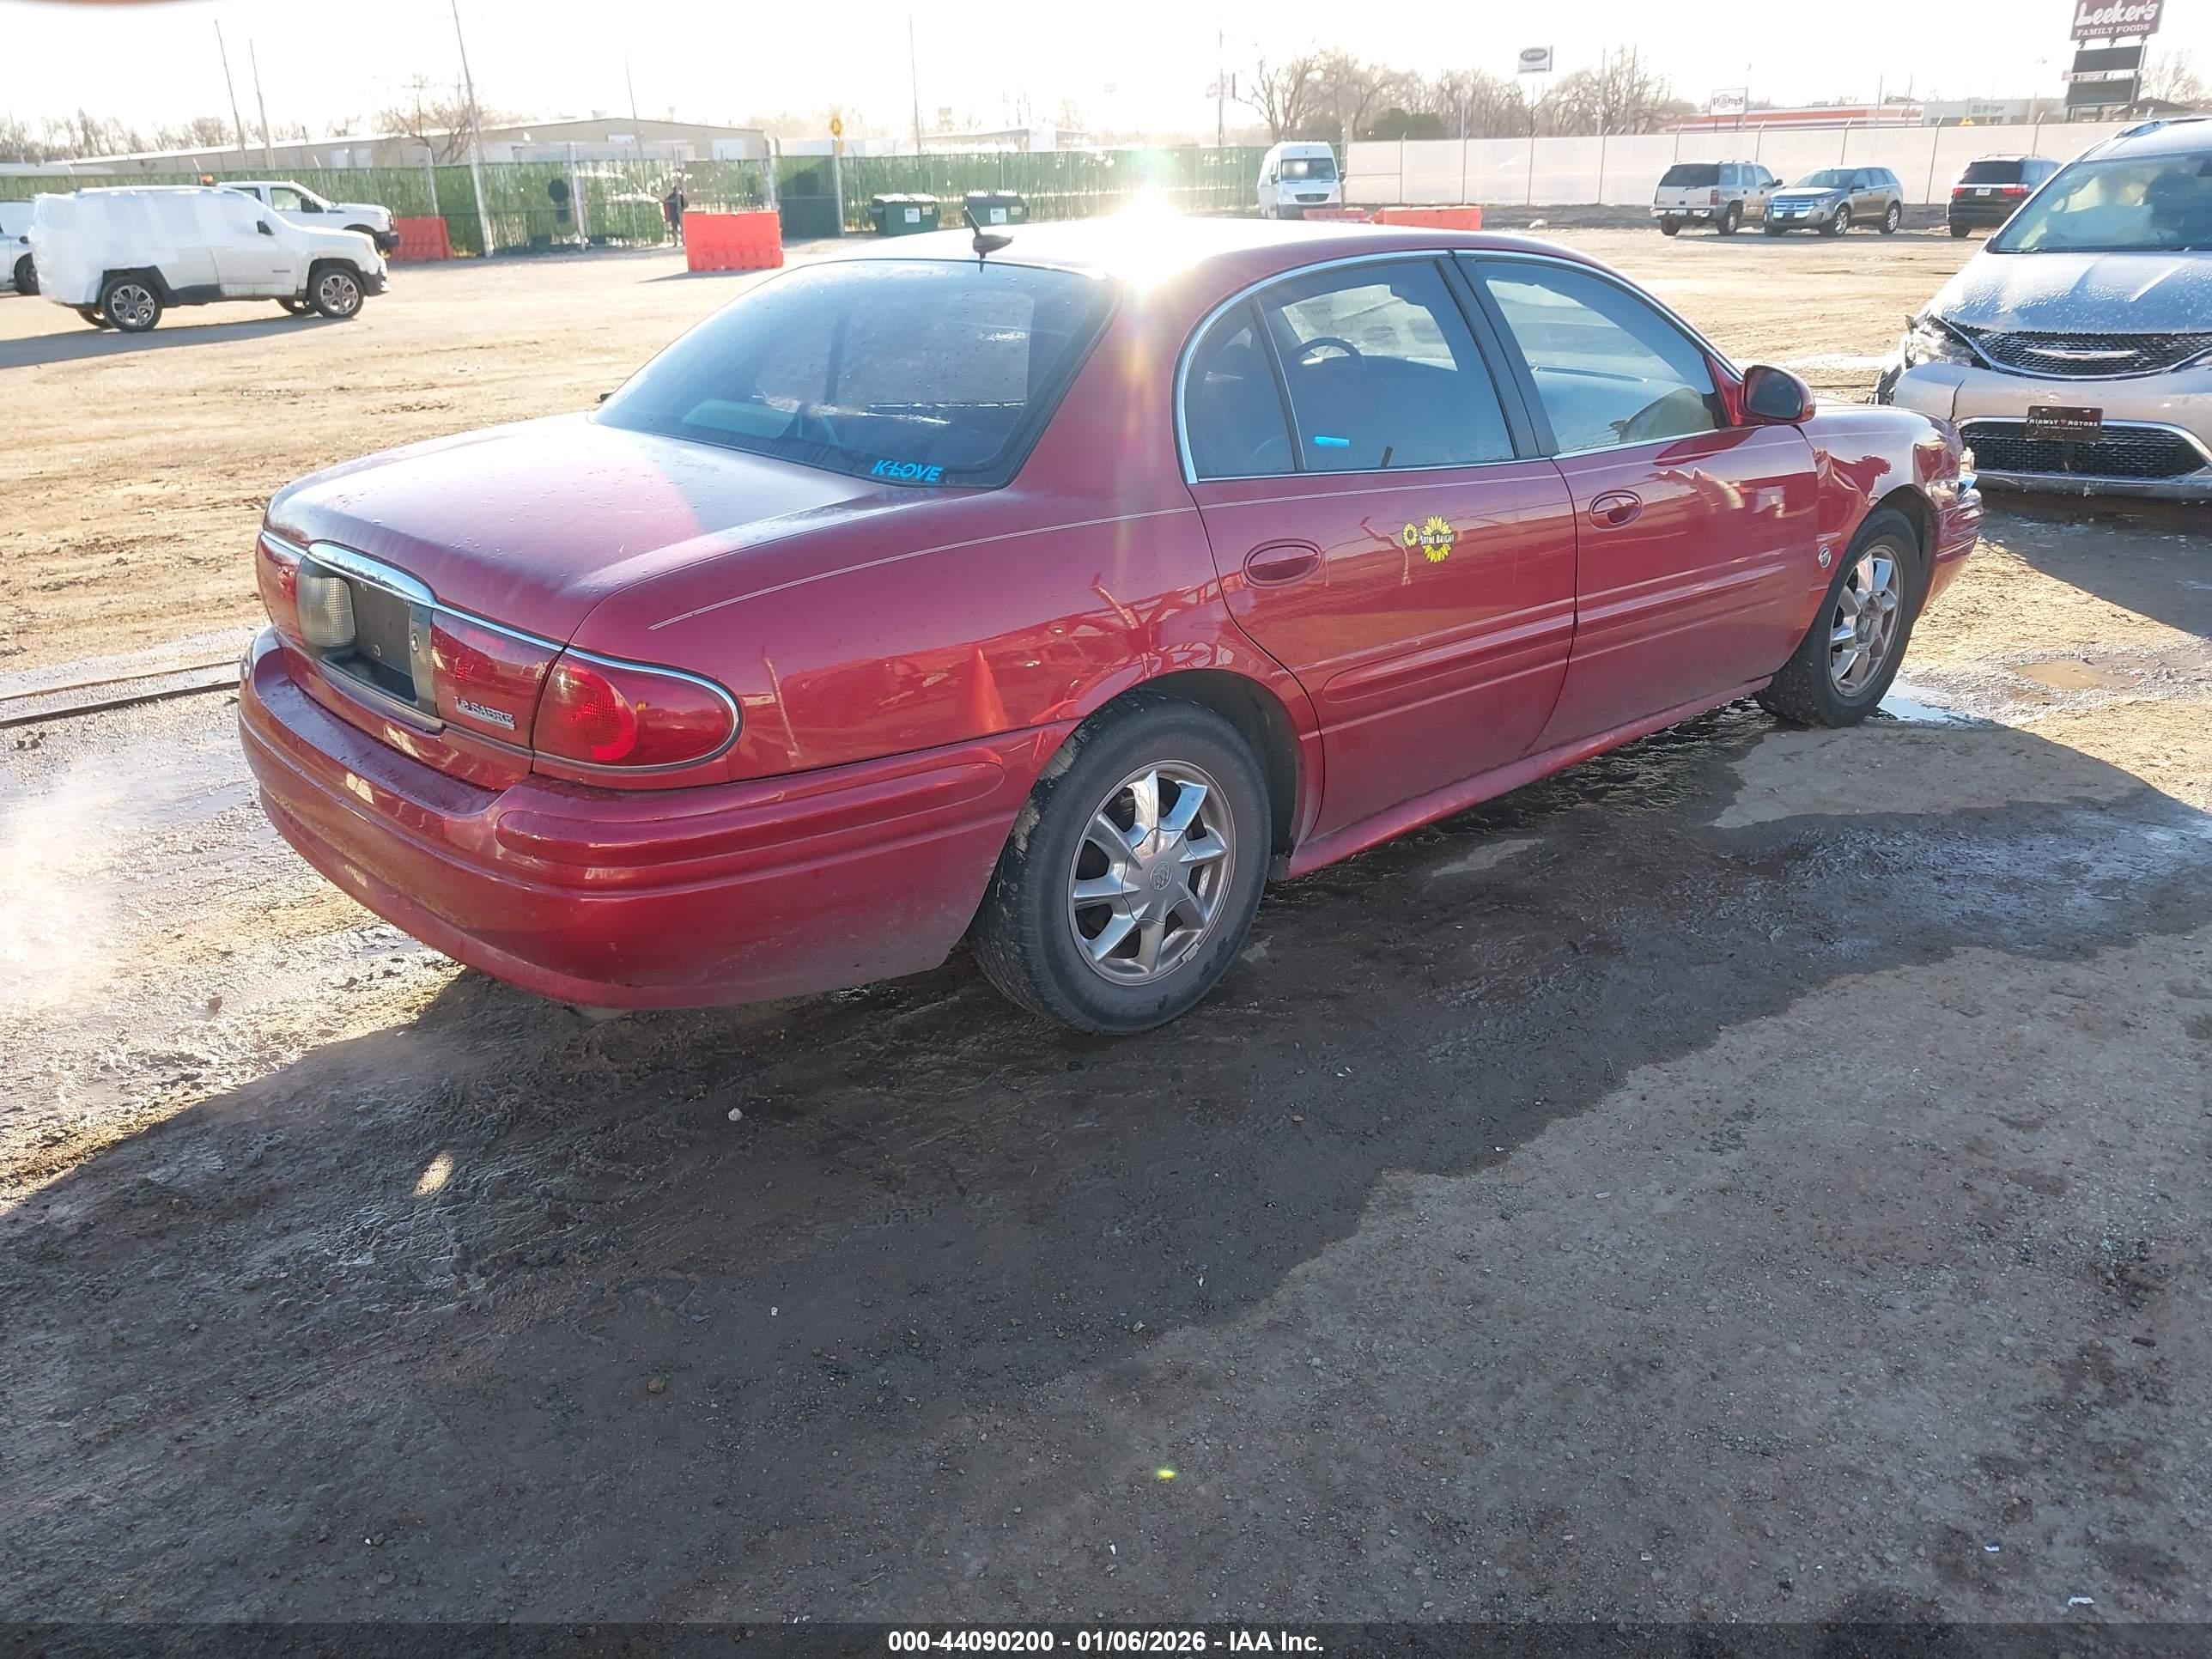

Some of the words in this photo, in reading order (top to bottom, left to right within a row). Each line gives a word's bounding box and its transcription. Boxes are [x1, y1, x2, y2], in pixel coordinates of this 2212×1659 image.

[2075, 0, 2159, 26] Leeker's
[2076, 27, 2113, 36] FAMILY
[2116, 23, 2150, 33] FOODS
